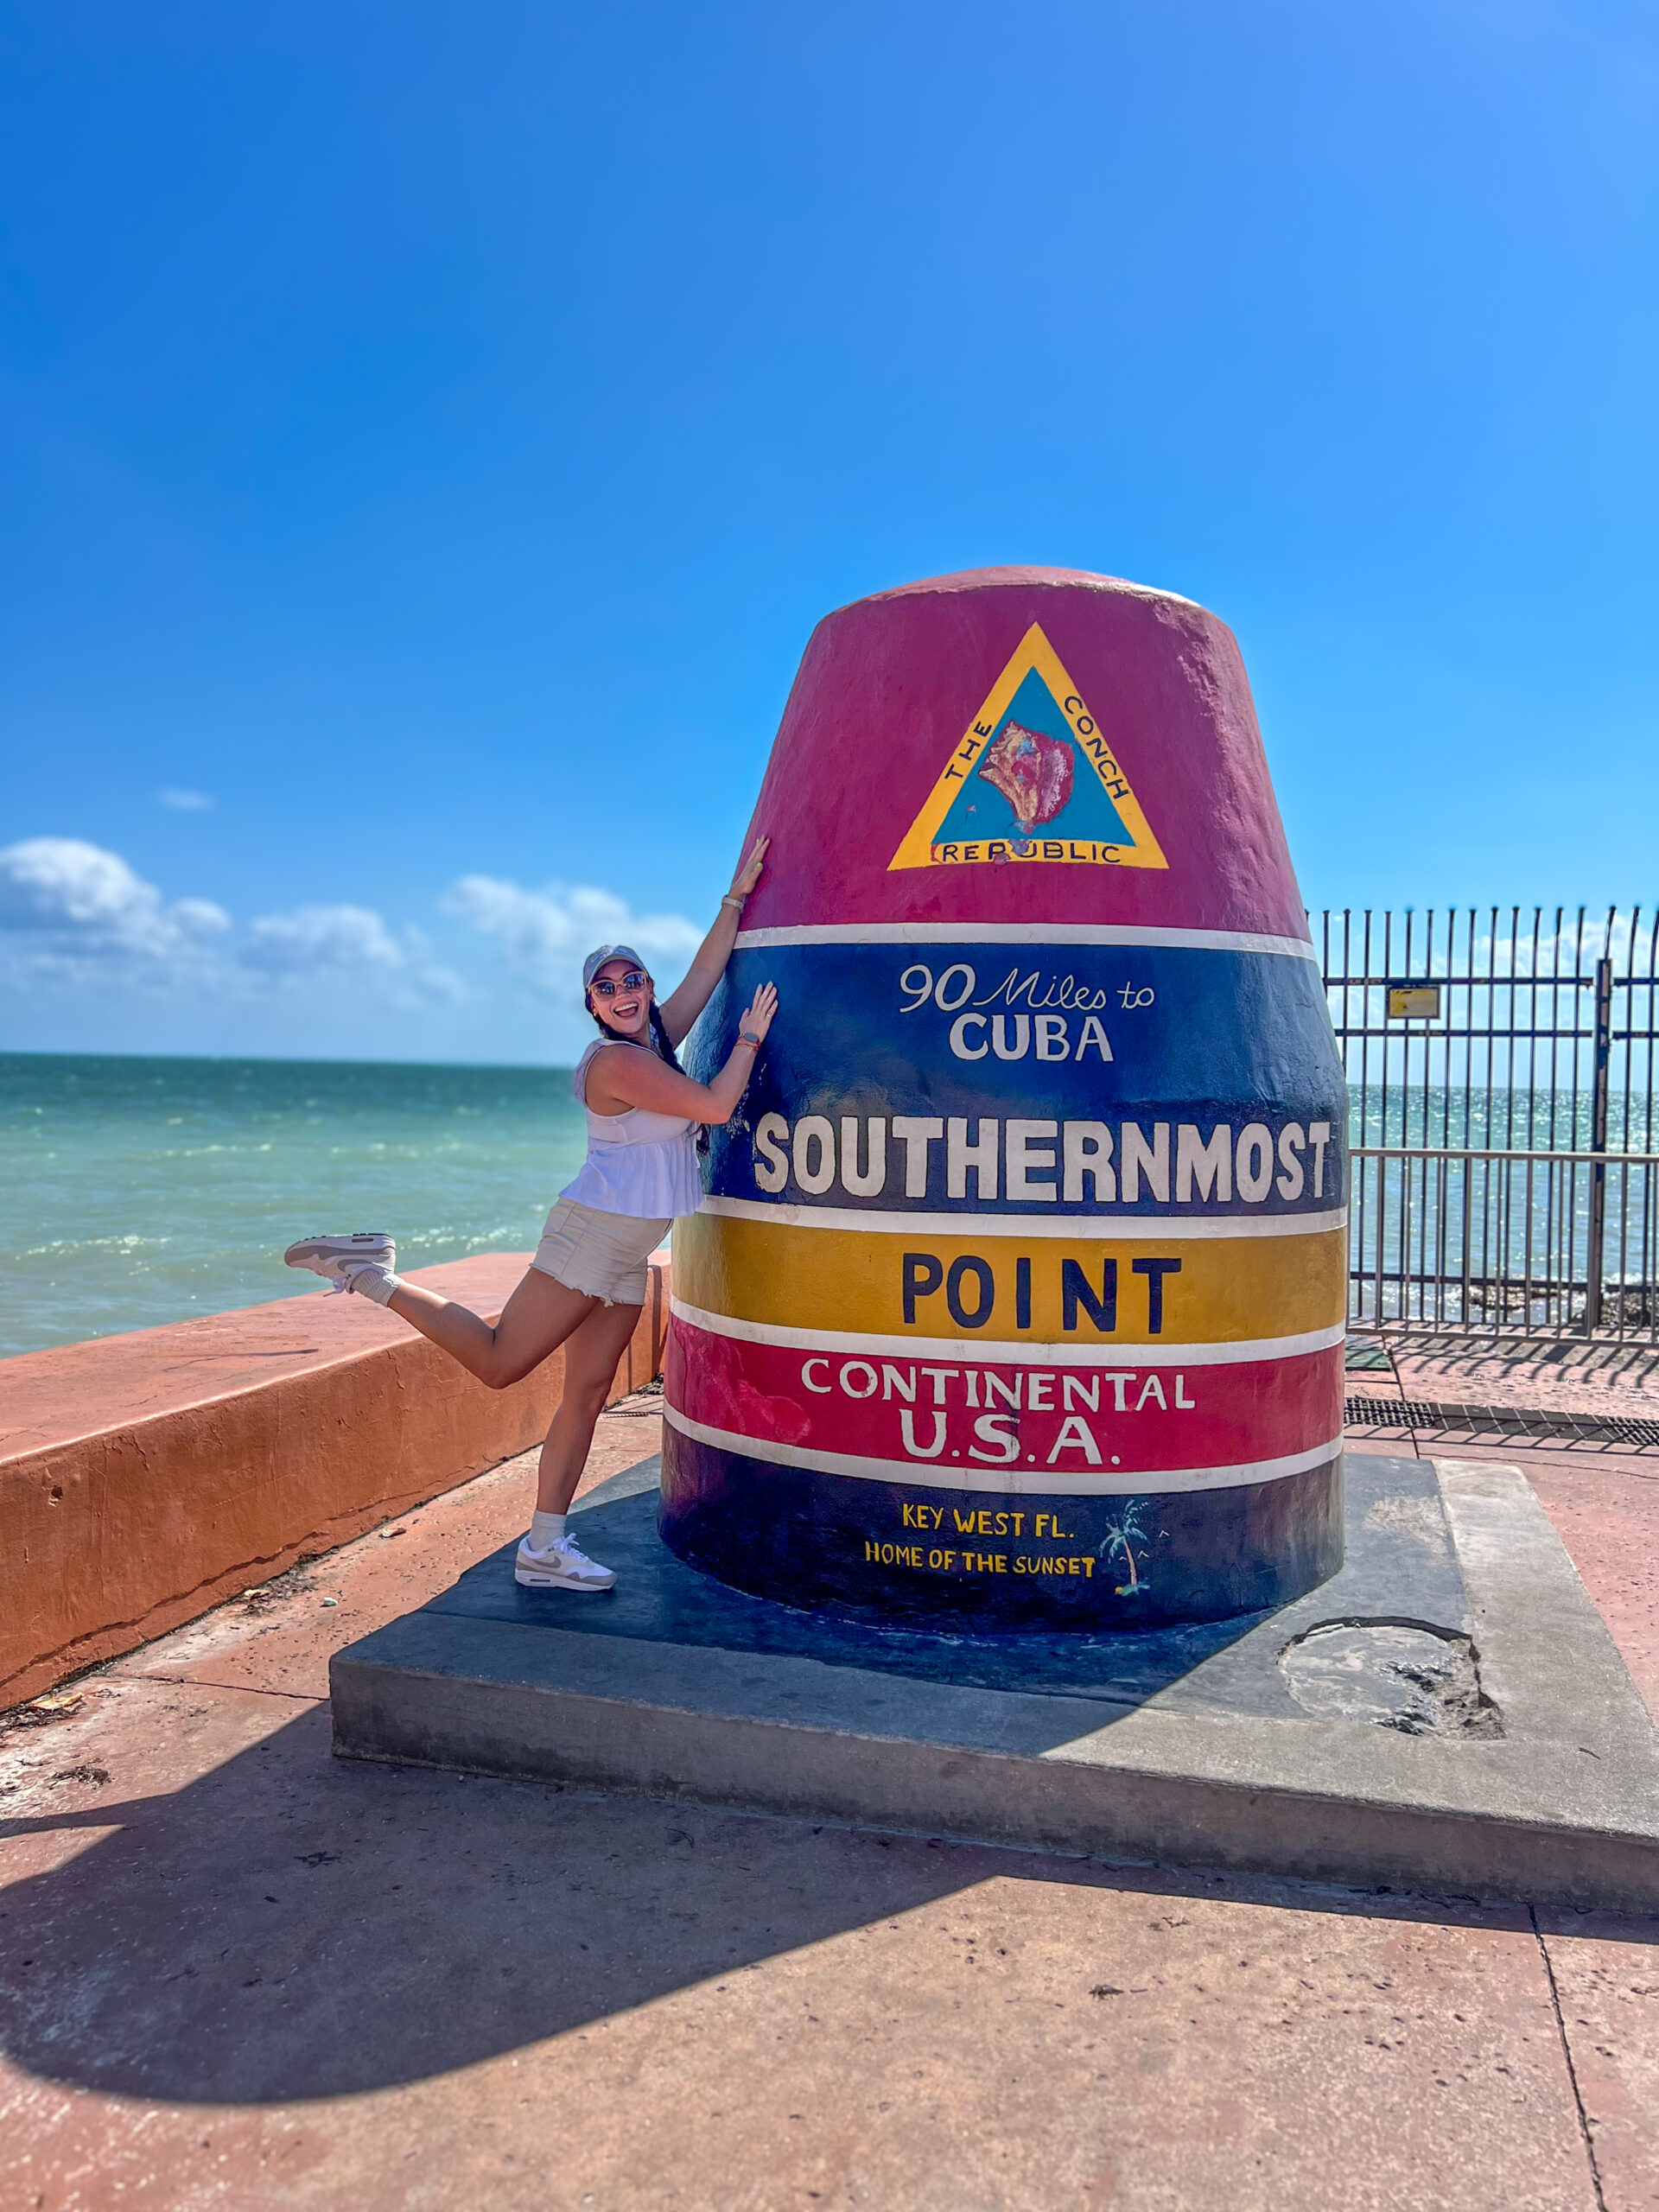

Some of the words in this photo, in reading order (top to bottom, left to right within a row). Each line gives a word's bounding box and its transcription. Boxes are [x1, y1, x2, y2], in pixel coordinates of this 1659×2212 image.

[944, 721, 992, 780] THE
[1064, 696, 1130, 800] CONCH
[899, 963, 976, 1013] 90
[972, 968, 1107, 1011] Miles
[1116, 981, 1155, 1009] to
[949, 1012, 1114, 1062] CUBA
[753, 1111, 1332, 1204] SOUTHERNMOST
[901, 1253, 1182, 1334] POINT
[801, 1358, 1196, 1413] CONTINENTAL
[899, 1408, 1121, 1465] U.S.A.
[902, 1503, 944, 1529] KEY
[953, 1509, 1026, 1537] WEST
[1034, 1513, 1075, 1539] FL.
[864, 1541, 924, 1568] HOME
[928, 1549, 957, 1570] OF
[962, 1552, 1008, 1573] THE
[1013, 1555, 1096, 1578] SUNSET
